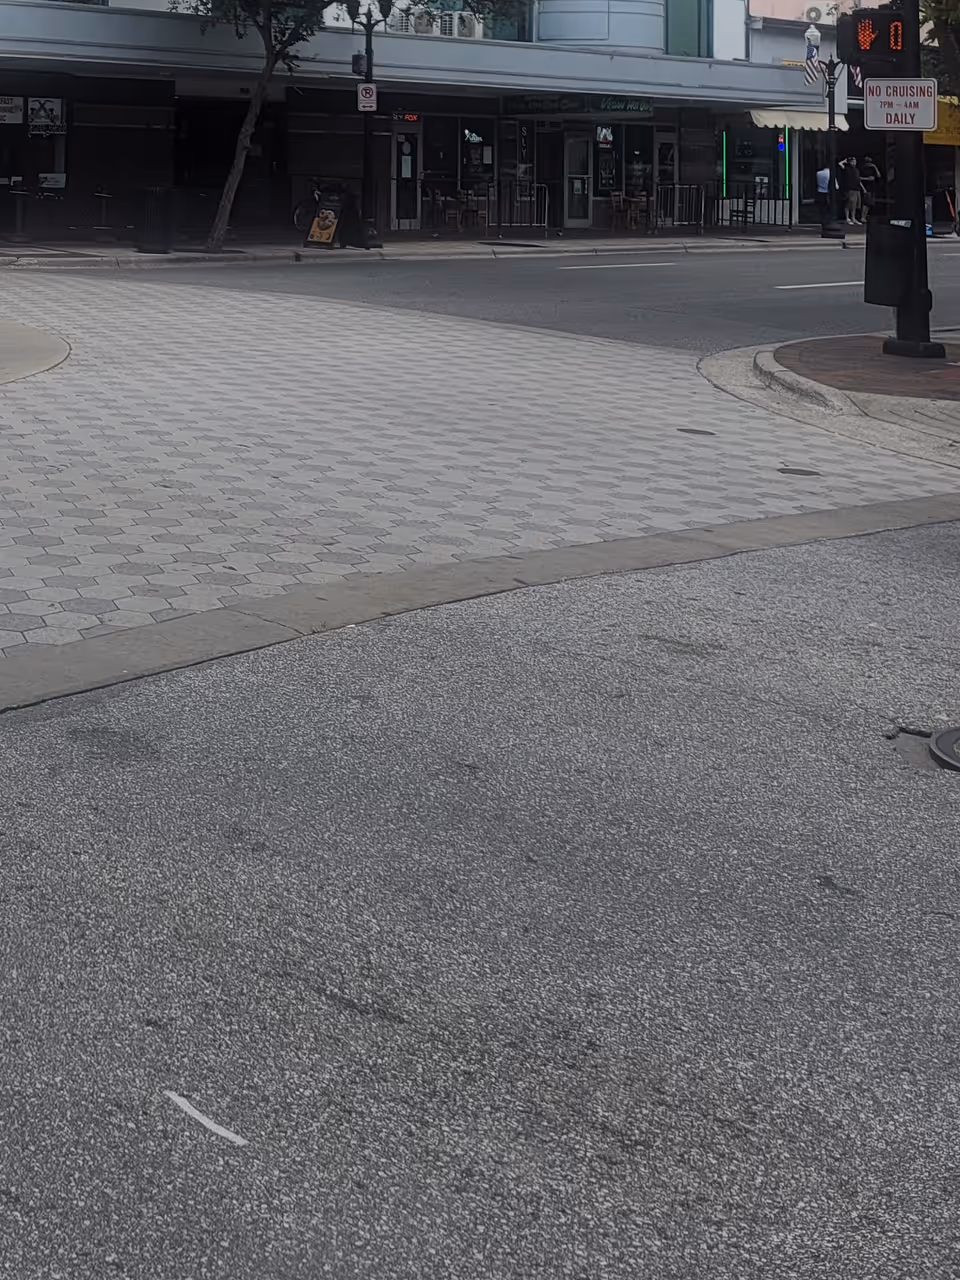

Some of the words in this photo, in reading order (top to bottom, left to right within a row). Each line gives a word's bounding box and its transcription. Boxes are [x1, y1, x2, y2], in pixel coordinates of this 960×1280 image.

[868, 85, 881, 97] NO
[886, 85, 932, 97] CRUISING
[880, 101, 894, 109] 7PM
[904, 101, 919, 109] 4AM
[885, 113, 916, 124] DAILY
